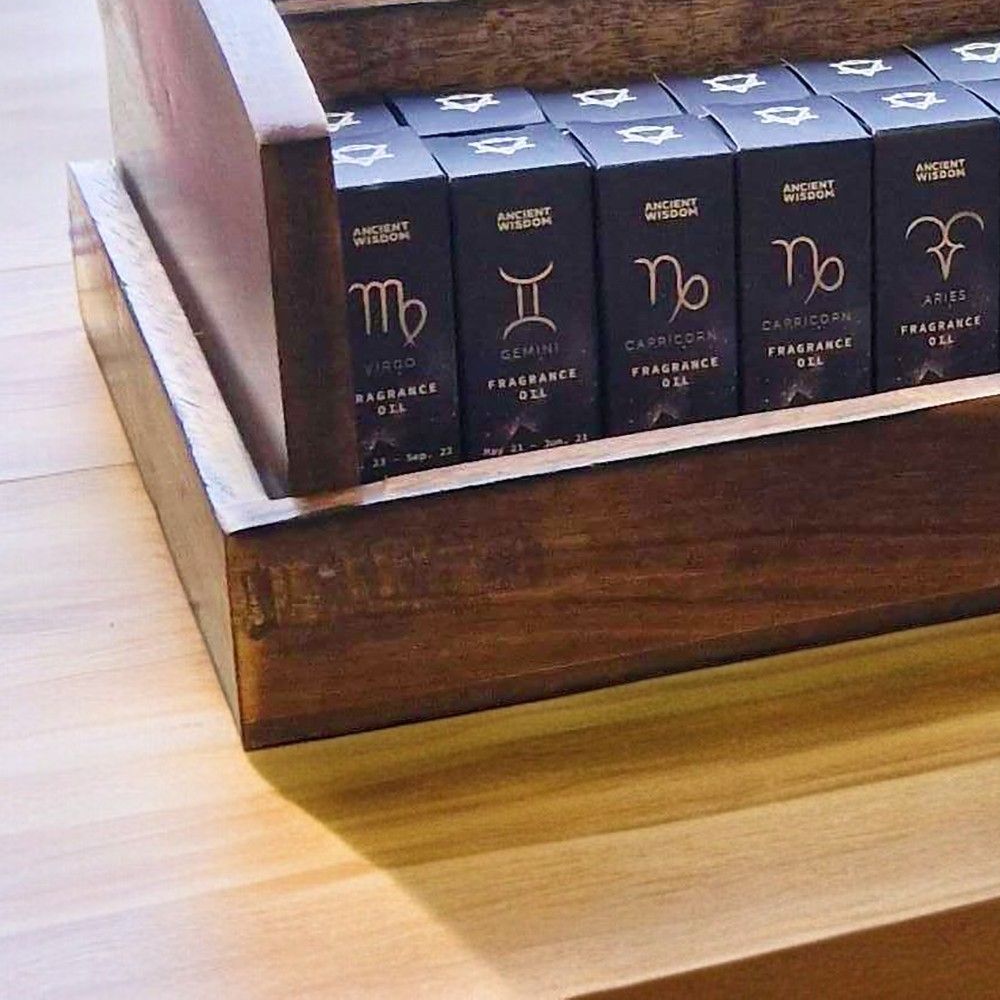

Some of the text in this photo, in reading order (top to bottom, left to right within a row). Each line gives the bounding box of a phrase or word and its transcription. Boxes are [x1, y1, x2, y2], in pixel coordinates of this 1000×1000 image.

[915, 158, 966, 174] ANCIENT
[915, 168, 967, 183] WISDOM
[783, 179, 836, 195] ANCIENT
[783, 188, 836, 204] WISDOM
[645, 197, 698, 212] ANCIENT
[497, 206, 552, 222] ANCIENT
[644, 206, 699, 222] WISDOM
[353, 220, 411, 238] ANCIENT
[497, 216, 553, 232] WISDOM
[353, 231, 412, 248] WISDOM
[921, 290, 967, 307] ARIES
[901, 315, 982, 336] FRAGRANCE
[767, 338, 853, 357] FRAGRANCE
[928, 334, 956, 347] OIL
[501, 343, 560, 361] GEMINI
[631, 356, 720, 378] FRAGRANCE
[797, 356, 825, 369] OIL
[487, 367, 578, 389] FRAGRANCE
[661, 375, 691, 389] OIL
[355, 382, 438, 404] RAGRANCE
[518, 388, 548, 401] OIL
[377, 400, 408, 417] OIL
